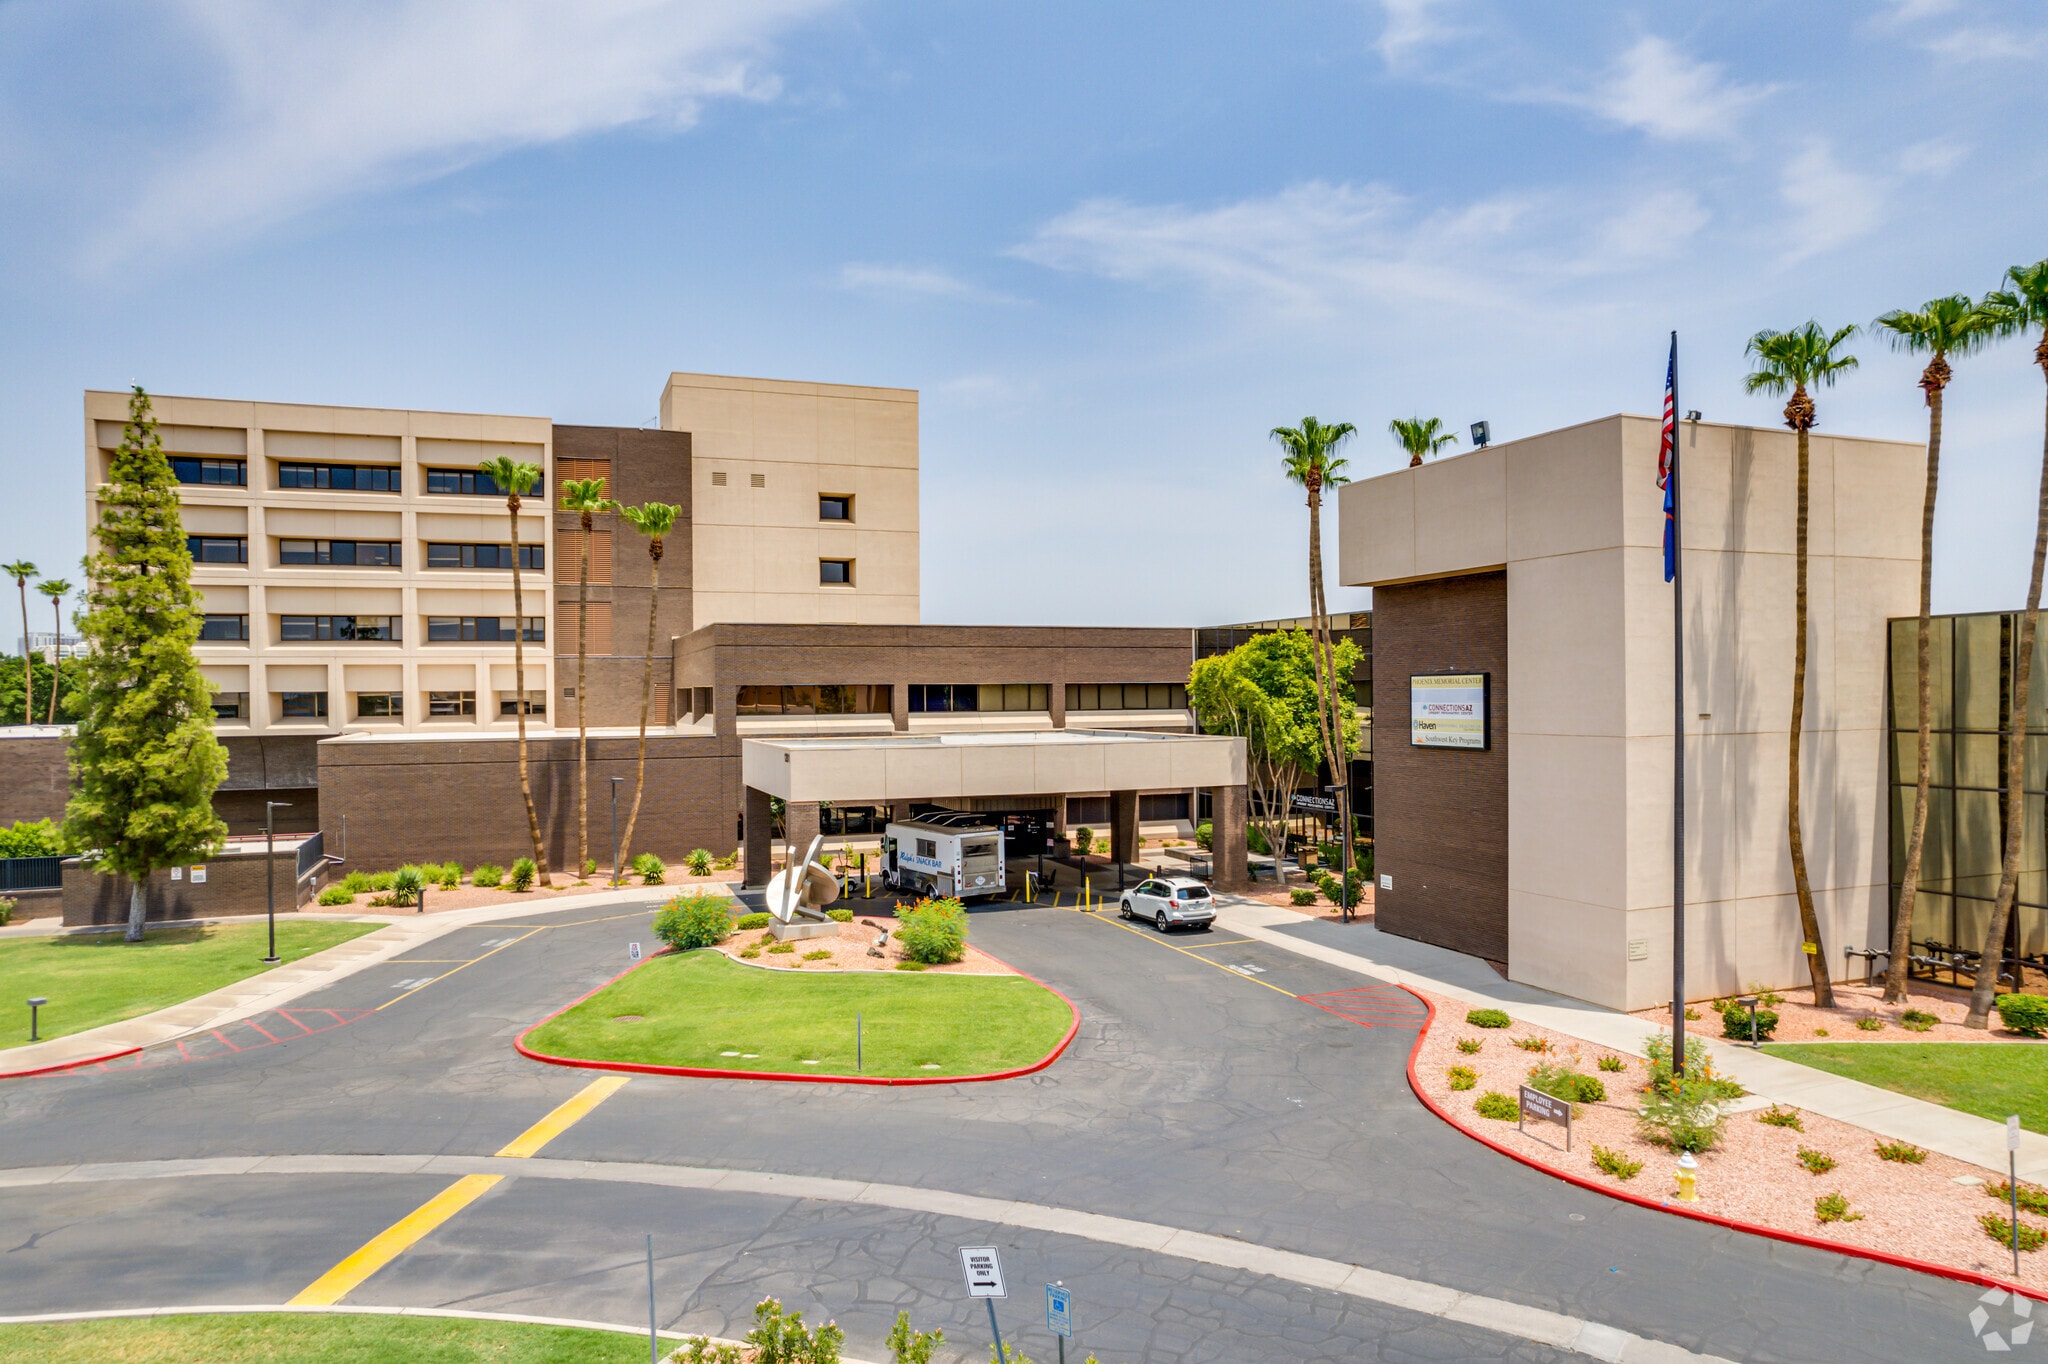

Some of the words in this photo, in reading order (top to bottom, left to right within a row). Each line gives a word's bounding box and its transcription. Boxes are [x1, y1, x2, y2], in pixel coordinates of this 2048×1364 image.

[1428, 703, 1473, 711] CONNECTIONSAZ
[1418, 720, 1437, 730] Haven
[1425, 735, 1448, 743] Southwest
[1448, 736, 1458, 744] Key
[1459, 737, 1481, 745] Programs
[1296, 794, 1335, 806] CONNECTIONSAZ
[916, 856, 931, 866] SNACK
[931, 859, 942, 868] BAR
[1524, 1090, 1552, 1108] EMPLOYEE
[1525, 1100, 1550, 1117] PARKING
